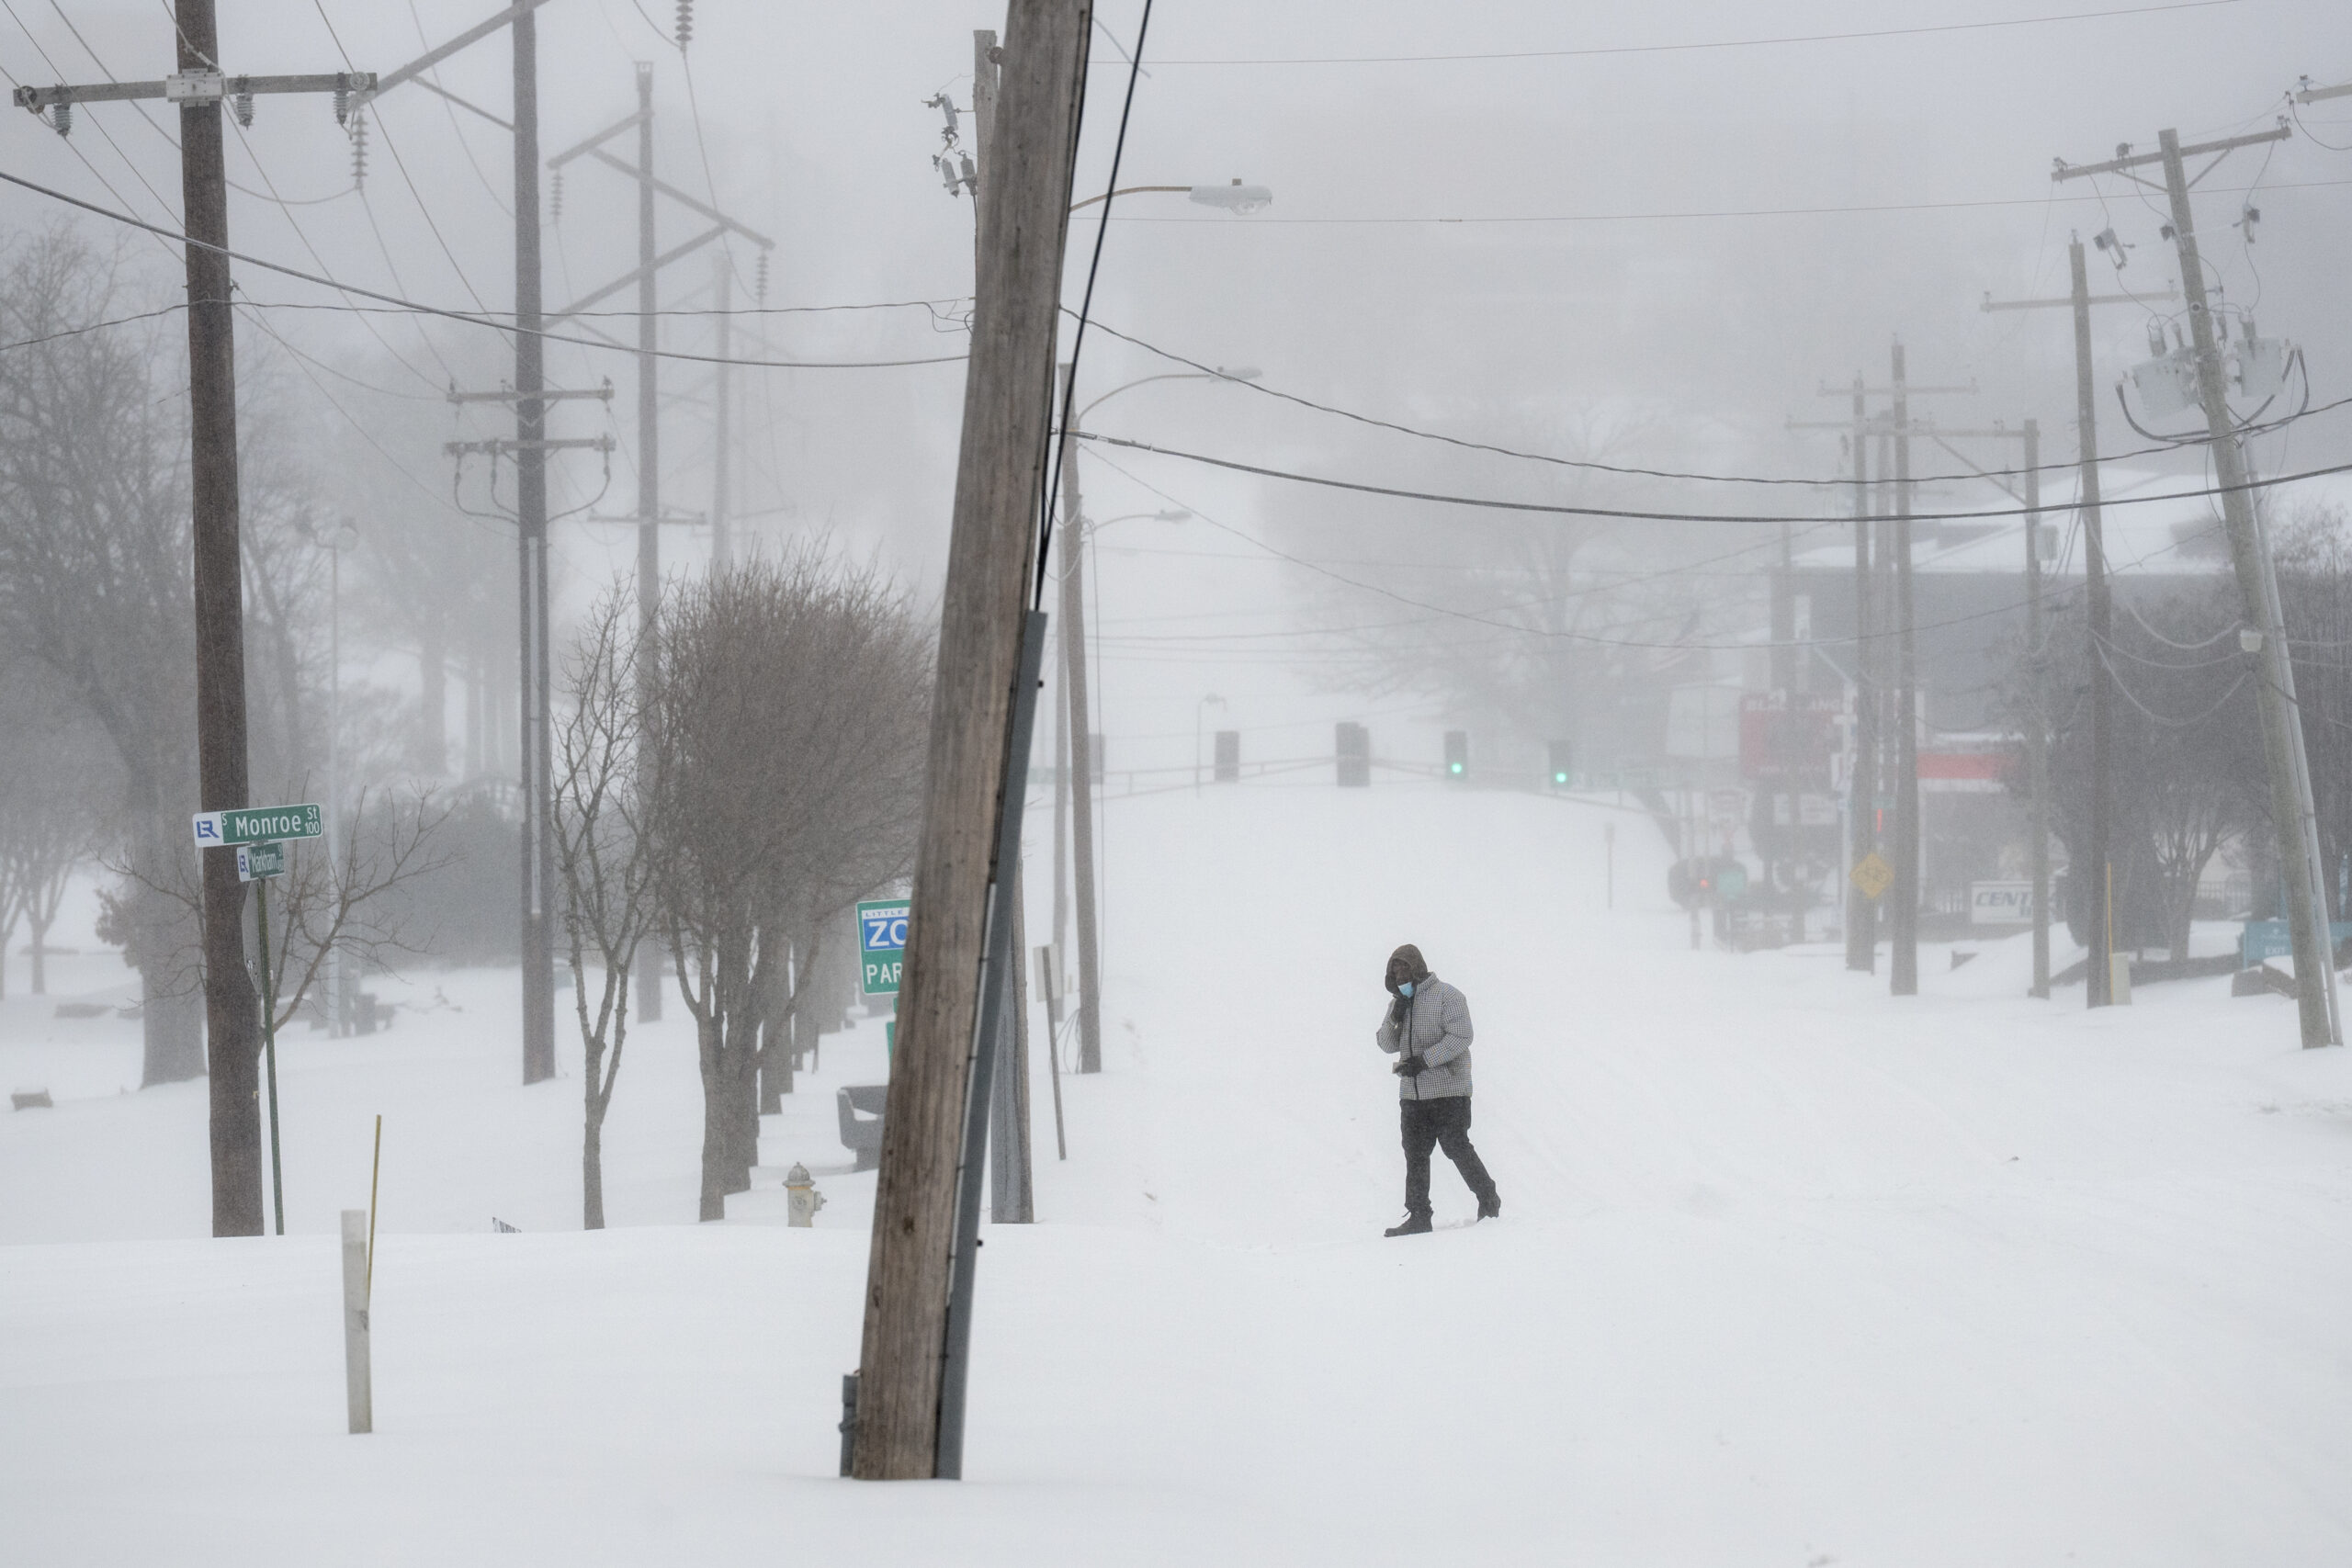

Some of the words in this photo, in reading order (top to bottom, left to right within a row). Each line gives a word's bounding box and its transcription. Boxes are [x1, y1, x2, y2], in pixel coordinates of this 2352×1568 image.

[221, 813, 228, 826] S
[235, 815, 301, 837] Monroe
[306, 807, 318, 819] St
[305, 821, 319, 835] 100
[1975, 891, 2033, 905] CENT
[865, 909, 903, 918] LITTLE
[868, 919, 908, 947] ZO
[866, 963, 903, 985] PAR
